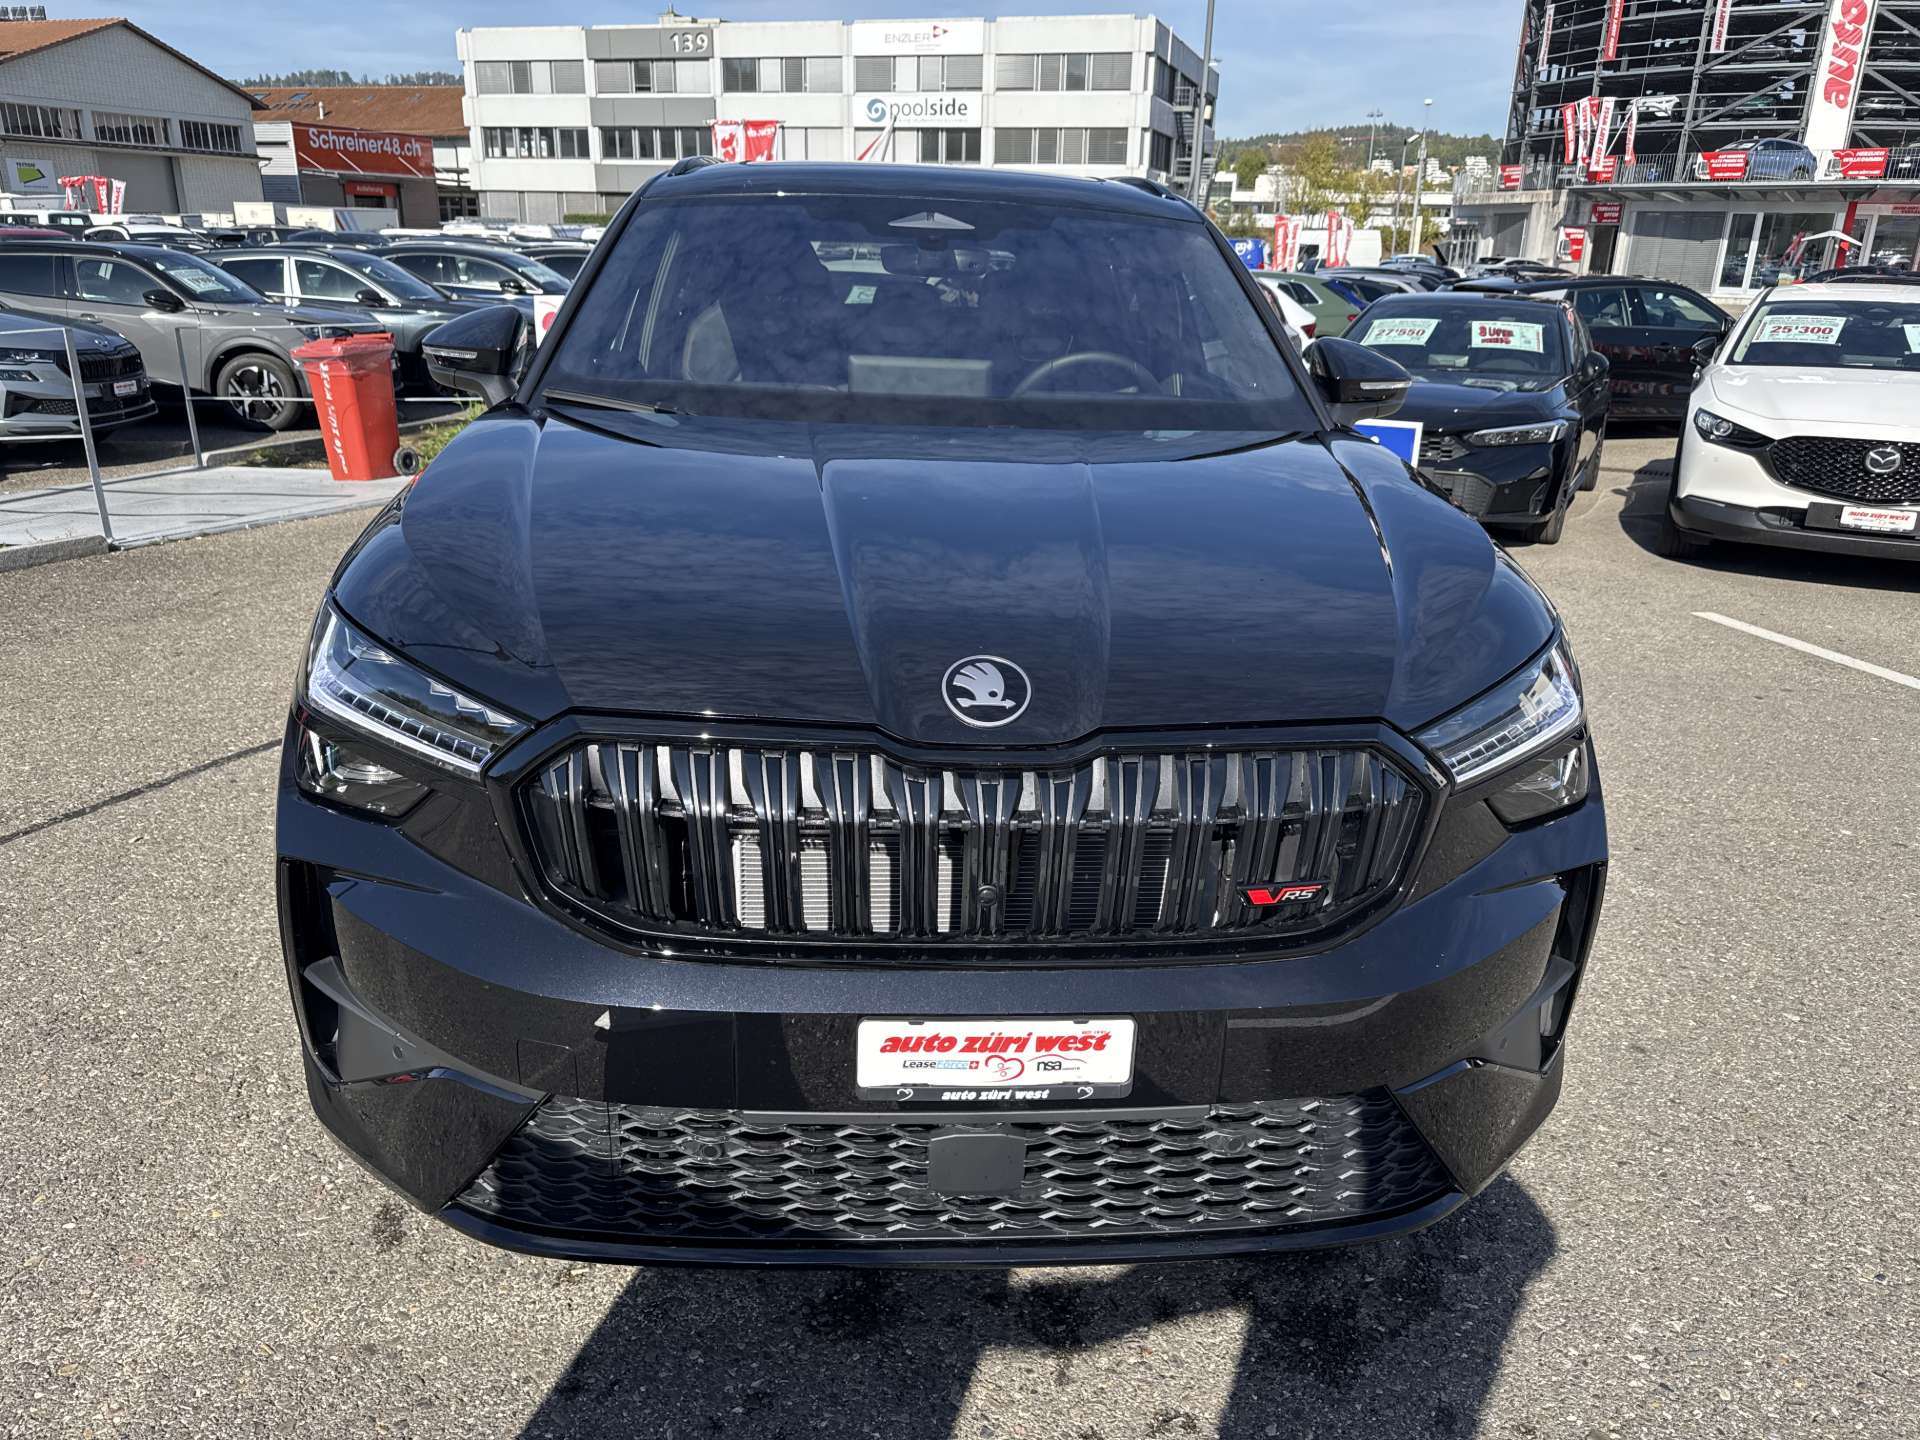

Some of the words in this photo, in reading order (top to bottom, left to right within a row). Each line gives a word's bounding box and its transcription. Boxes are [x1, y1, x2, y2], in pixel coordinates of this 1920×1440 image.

[669, 32, 708, 53] 139
[884, 33, 931, 44] ENZLER
[1824, 0, 1868, 109] auto
[890, 97, 968, 119] poolside
[308, 127, 422, 157] Schreiner48.ch
[1770, 325, 1834, 335] 25'300
[880, 1032, 958, 1053] auto
[959, 1031, 1033, 1053] züri
[1035, 1031, 1112, 1052] west
[1037, 1060, 1062, 1072] nsa
[941, 1089, 977, 1100] auto
[978, 1088, 1013, 1100] züri
[1015, 1088, 1050, 1100] west
